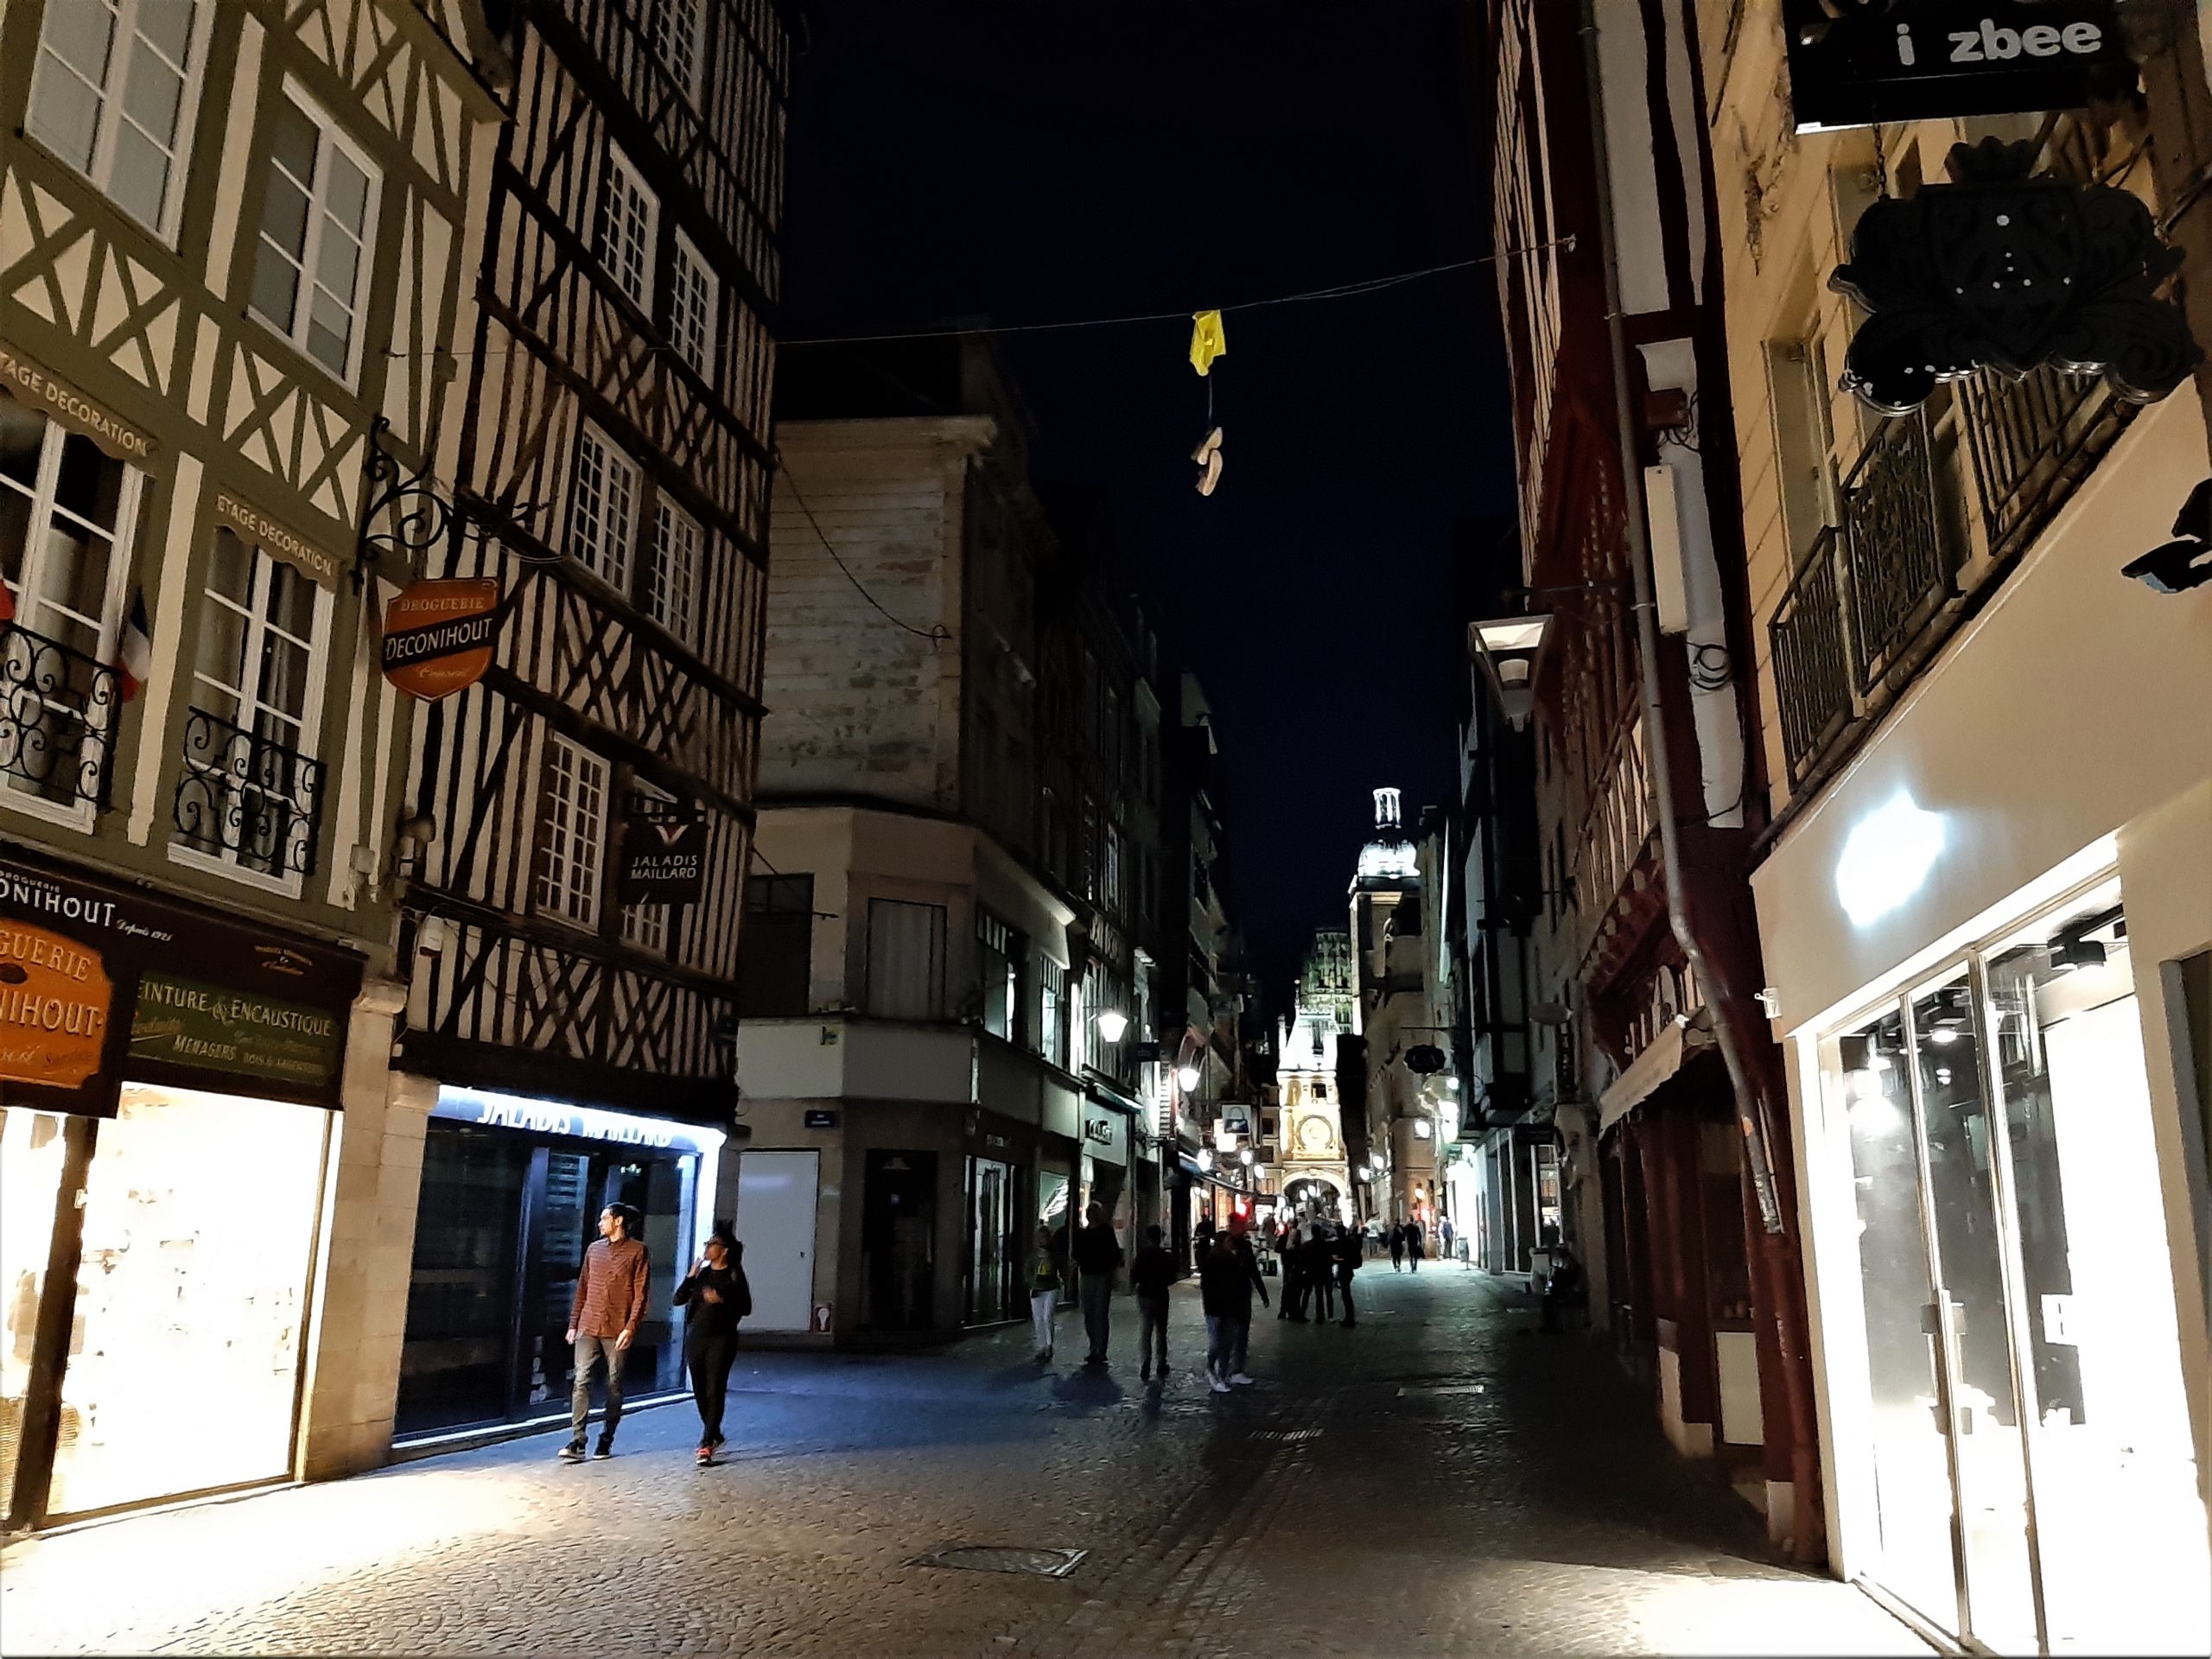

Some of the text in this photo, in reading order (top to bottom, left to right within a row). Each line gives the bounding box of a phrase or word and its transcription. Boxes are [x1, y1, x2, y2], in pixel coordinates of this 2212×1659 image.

[1948, 18, 2102, 63] zbee
[46, 381, 147, 457] DECORATION
[259, 520, 334, 576] DECORATION
[400, 598, 484, 612] DROGUERIE
[385, 618, 493, 660] DECONIHOUT
[631, 867, 697, 880] MAILLARD
[632, 854, 697, 868] JALADIS
[0, 878, 116, 927] ONIHOUT
[0, 930, 91, 982] GUERIE
[231, 999, 332, 1038] ENCAUSTIQUE
[477, 1103, 570, 1135] JALADIS
